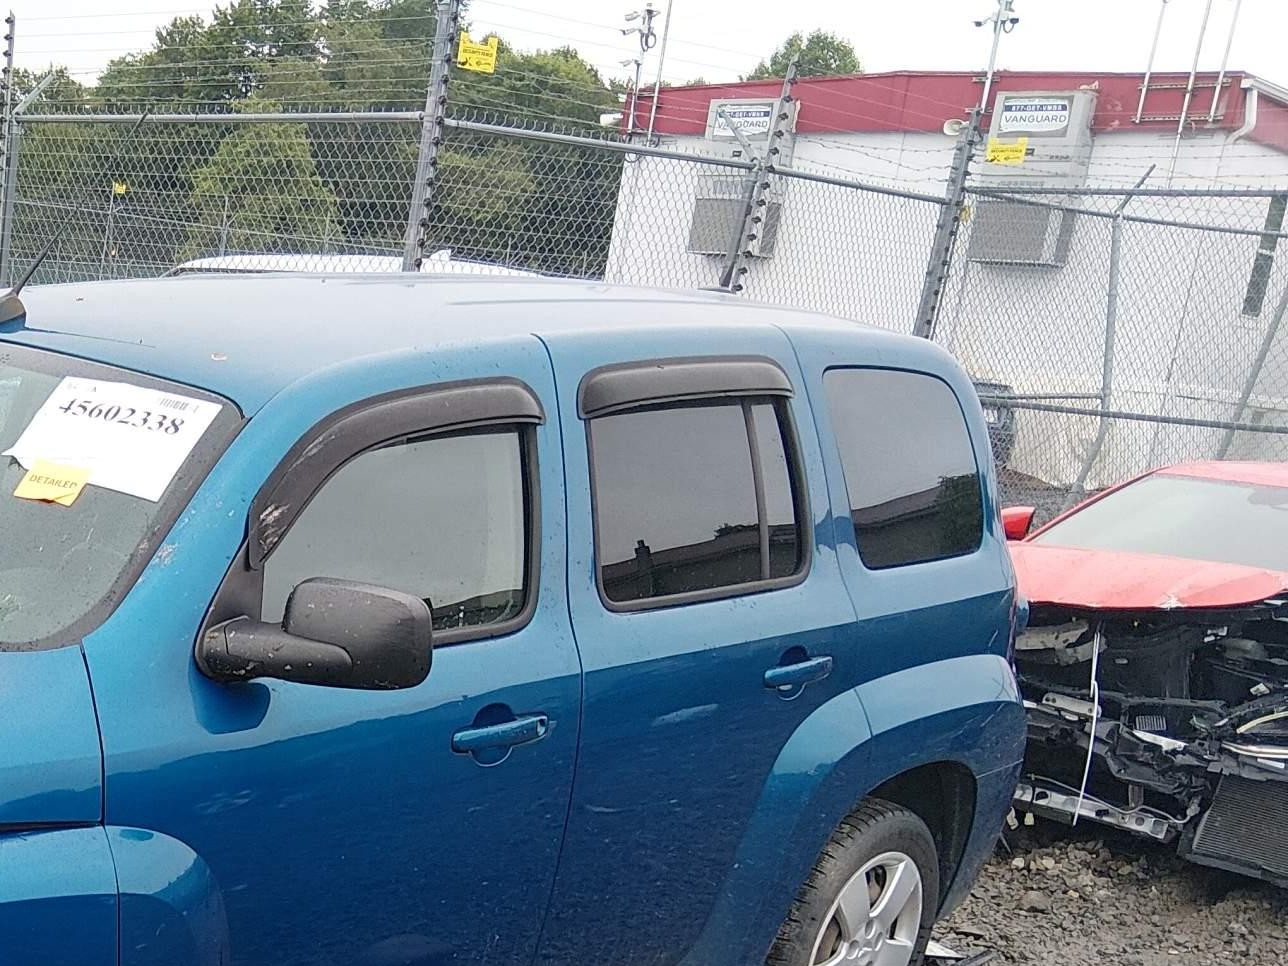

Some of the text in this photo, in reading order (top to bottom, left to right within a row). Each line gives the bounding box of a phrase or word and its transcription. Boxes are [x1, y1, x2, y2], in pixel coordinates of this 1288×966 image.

[1005, 114, 1067, 123] VANGUARD
[59, 398, 185, 435] 45602338
[29, 473, 78, 490] DETAILED
